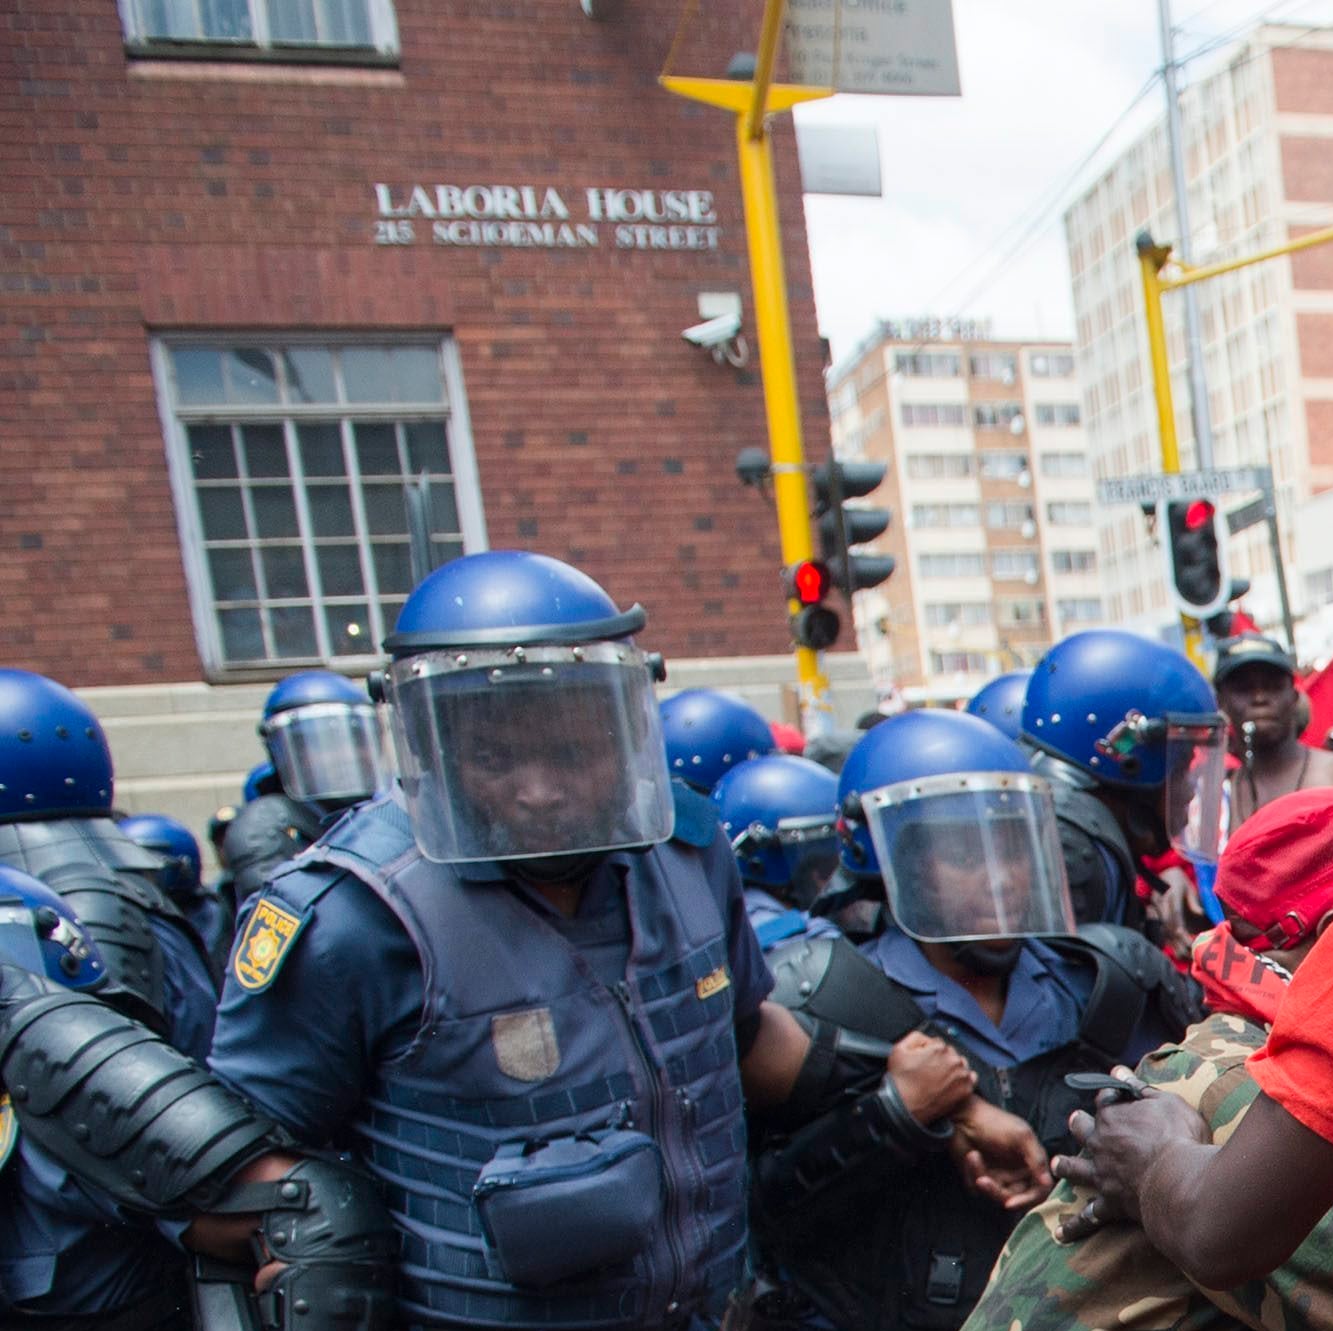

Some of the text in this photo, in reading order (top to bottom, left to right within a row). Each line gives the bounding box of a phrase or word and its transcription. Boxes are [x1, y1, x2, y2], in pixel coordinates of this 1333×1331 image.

[375, 182, 717, 224] LABORIA HOUSE
[374, 220, 720, 250] 215 SCHOEMAN STREET
